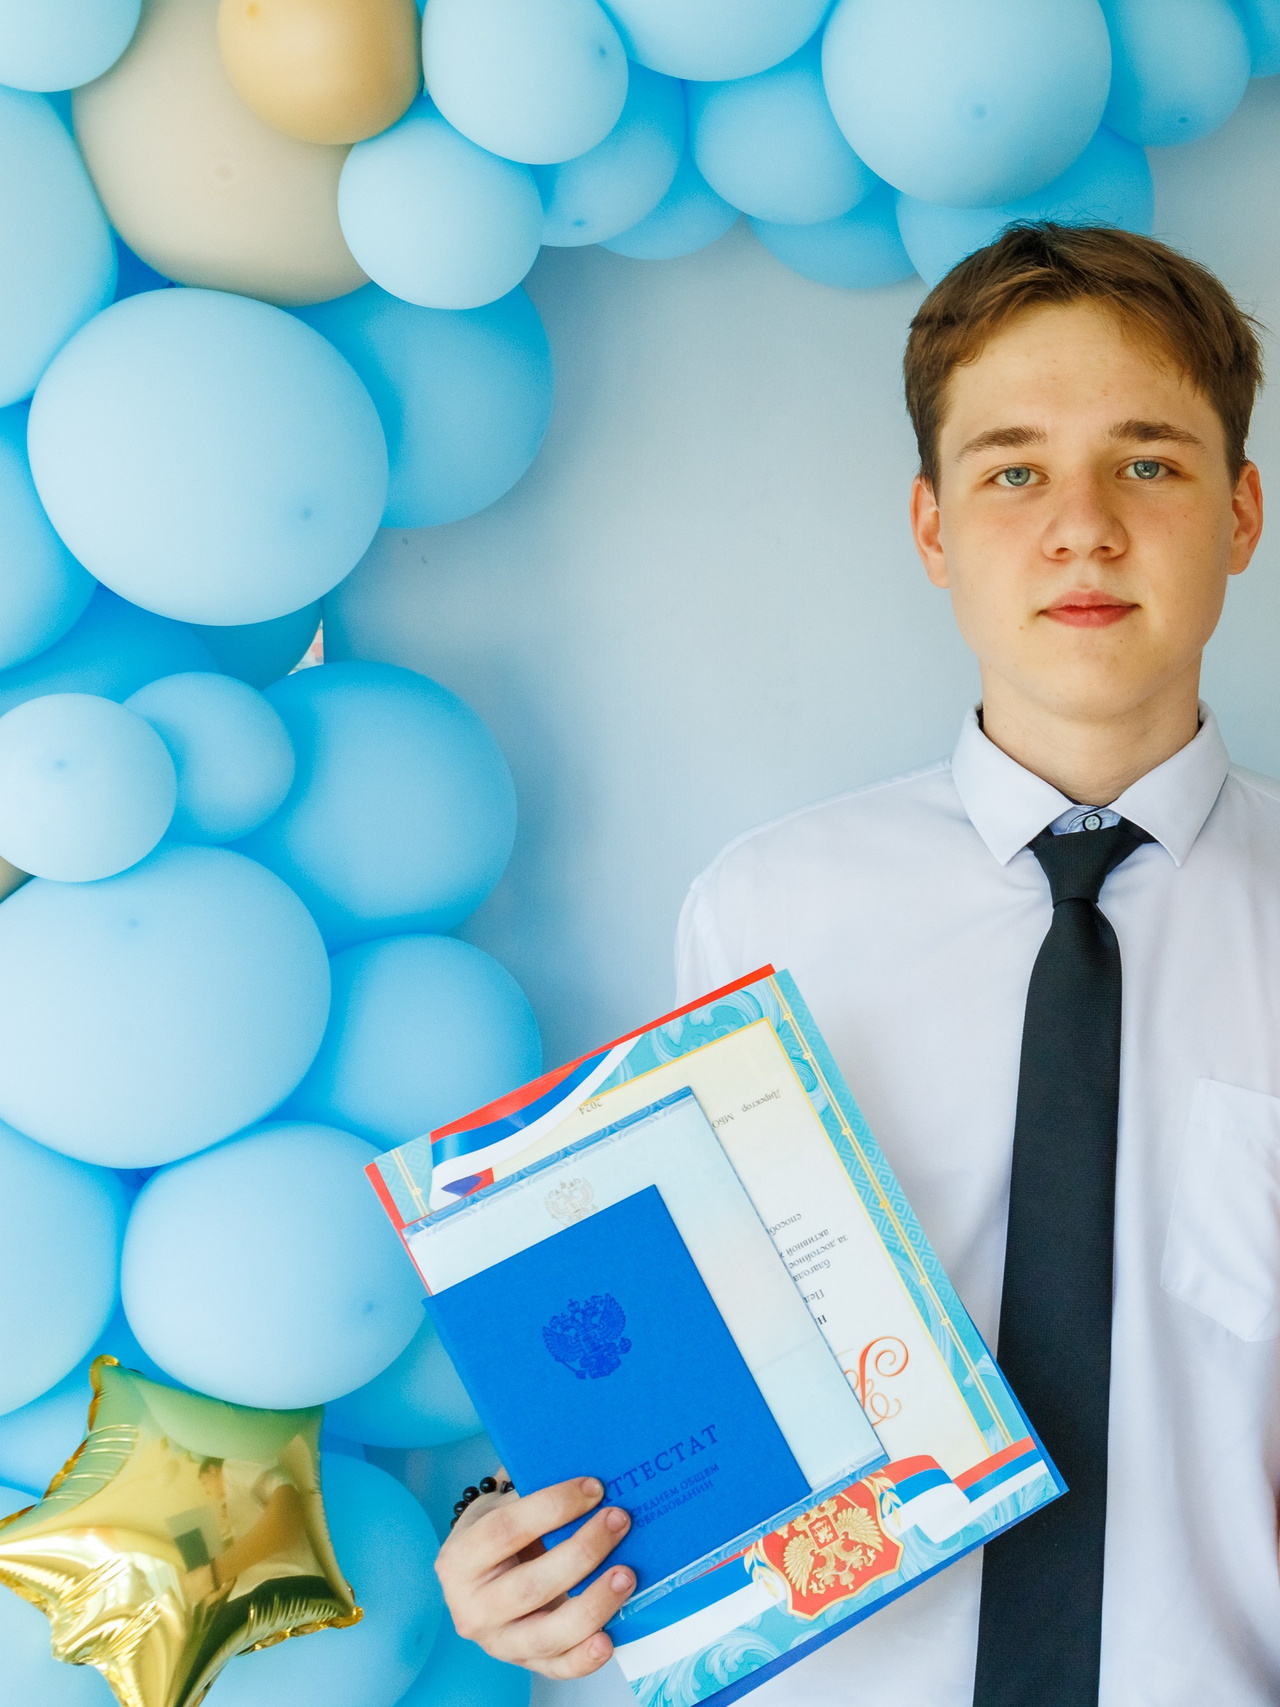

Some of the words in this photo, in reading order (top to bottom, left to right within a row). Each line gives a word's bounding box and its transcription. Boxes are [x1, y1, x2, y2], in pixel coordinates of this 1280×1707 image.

[578, 1098, 603, 1115] 2024
[766, 1213, 802, 1236] способ
[786, 1229, 829, 1256] активной
[837, 1234, 848, 1244] за
[788, 1239, 836, 1269] достойное
[680, 1463, 720, 1490] ОБЩЕМ
[636, 1480, 715, 1528] ОБРАЗОВАНИИ
